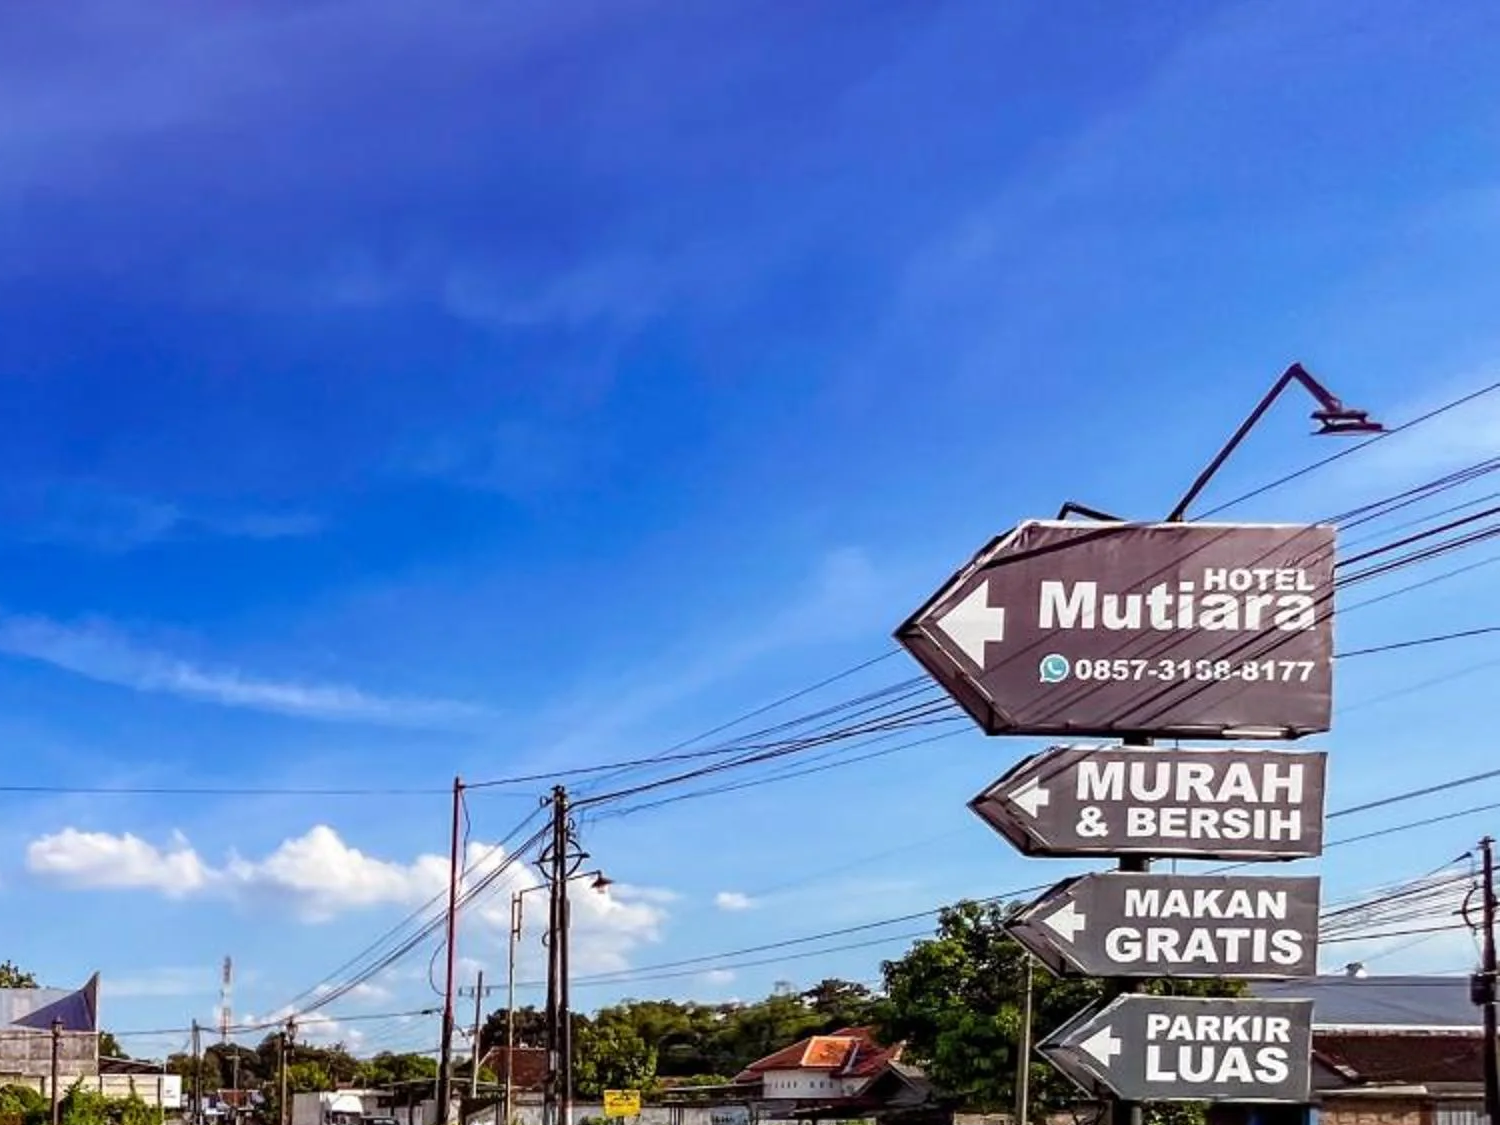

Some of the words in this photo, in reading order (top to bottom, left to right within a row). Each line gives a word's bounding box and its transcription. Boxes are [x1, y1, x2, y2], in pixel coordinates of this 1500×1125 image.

[1203, 568, 1315, 592] HOTEL
[1039, 581, 1316, 631] Mutiara
[1075, 658, 1315, 682] 0857-3158-8177
[1076, 761, 1304, 803] MURAH
[1075, 806, 1109, 838] &
[1127, 807, 1301, 841] BERSIH
[1125, 888, 1287, 919] MAKAN
[1105, 927, 1303, 965] GRATIS
[1146, 1013, 1291, 1043] PARKIR
[1146, 1045, 1289, 1083] LUAS
